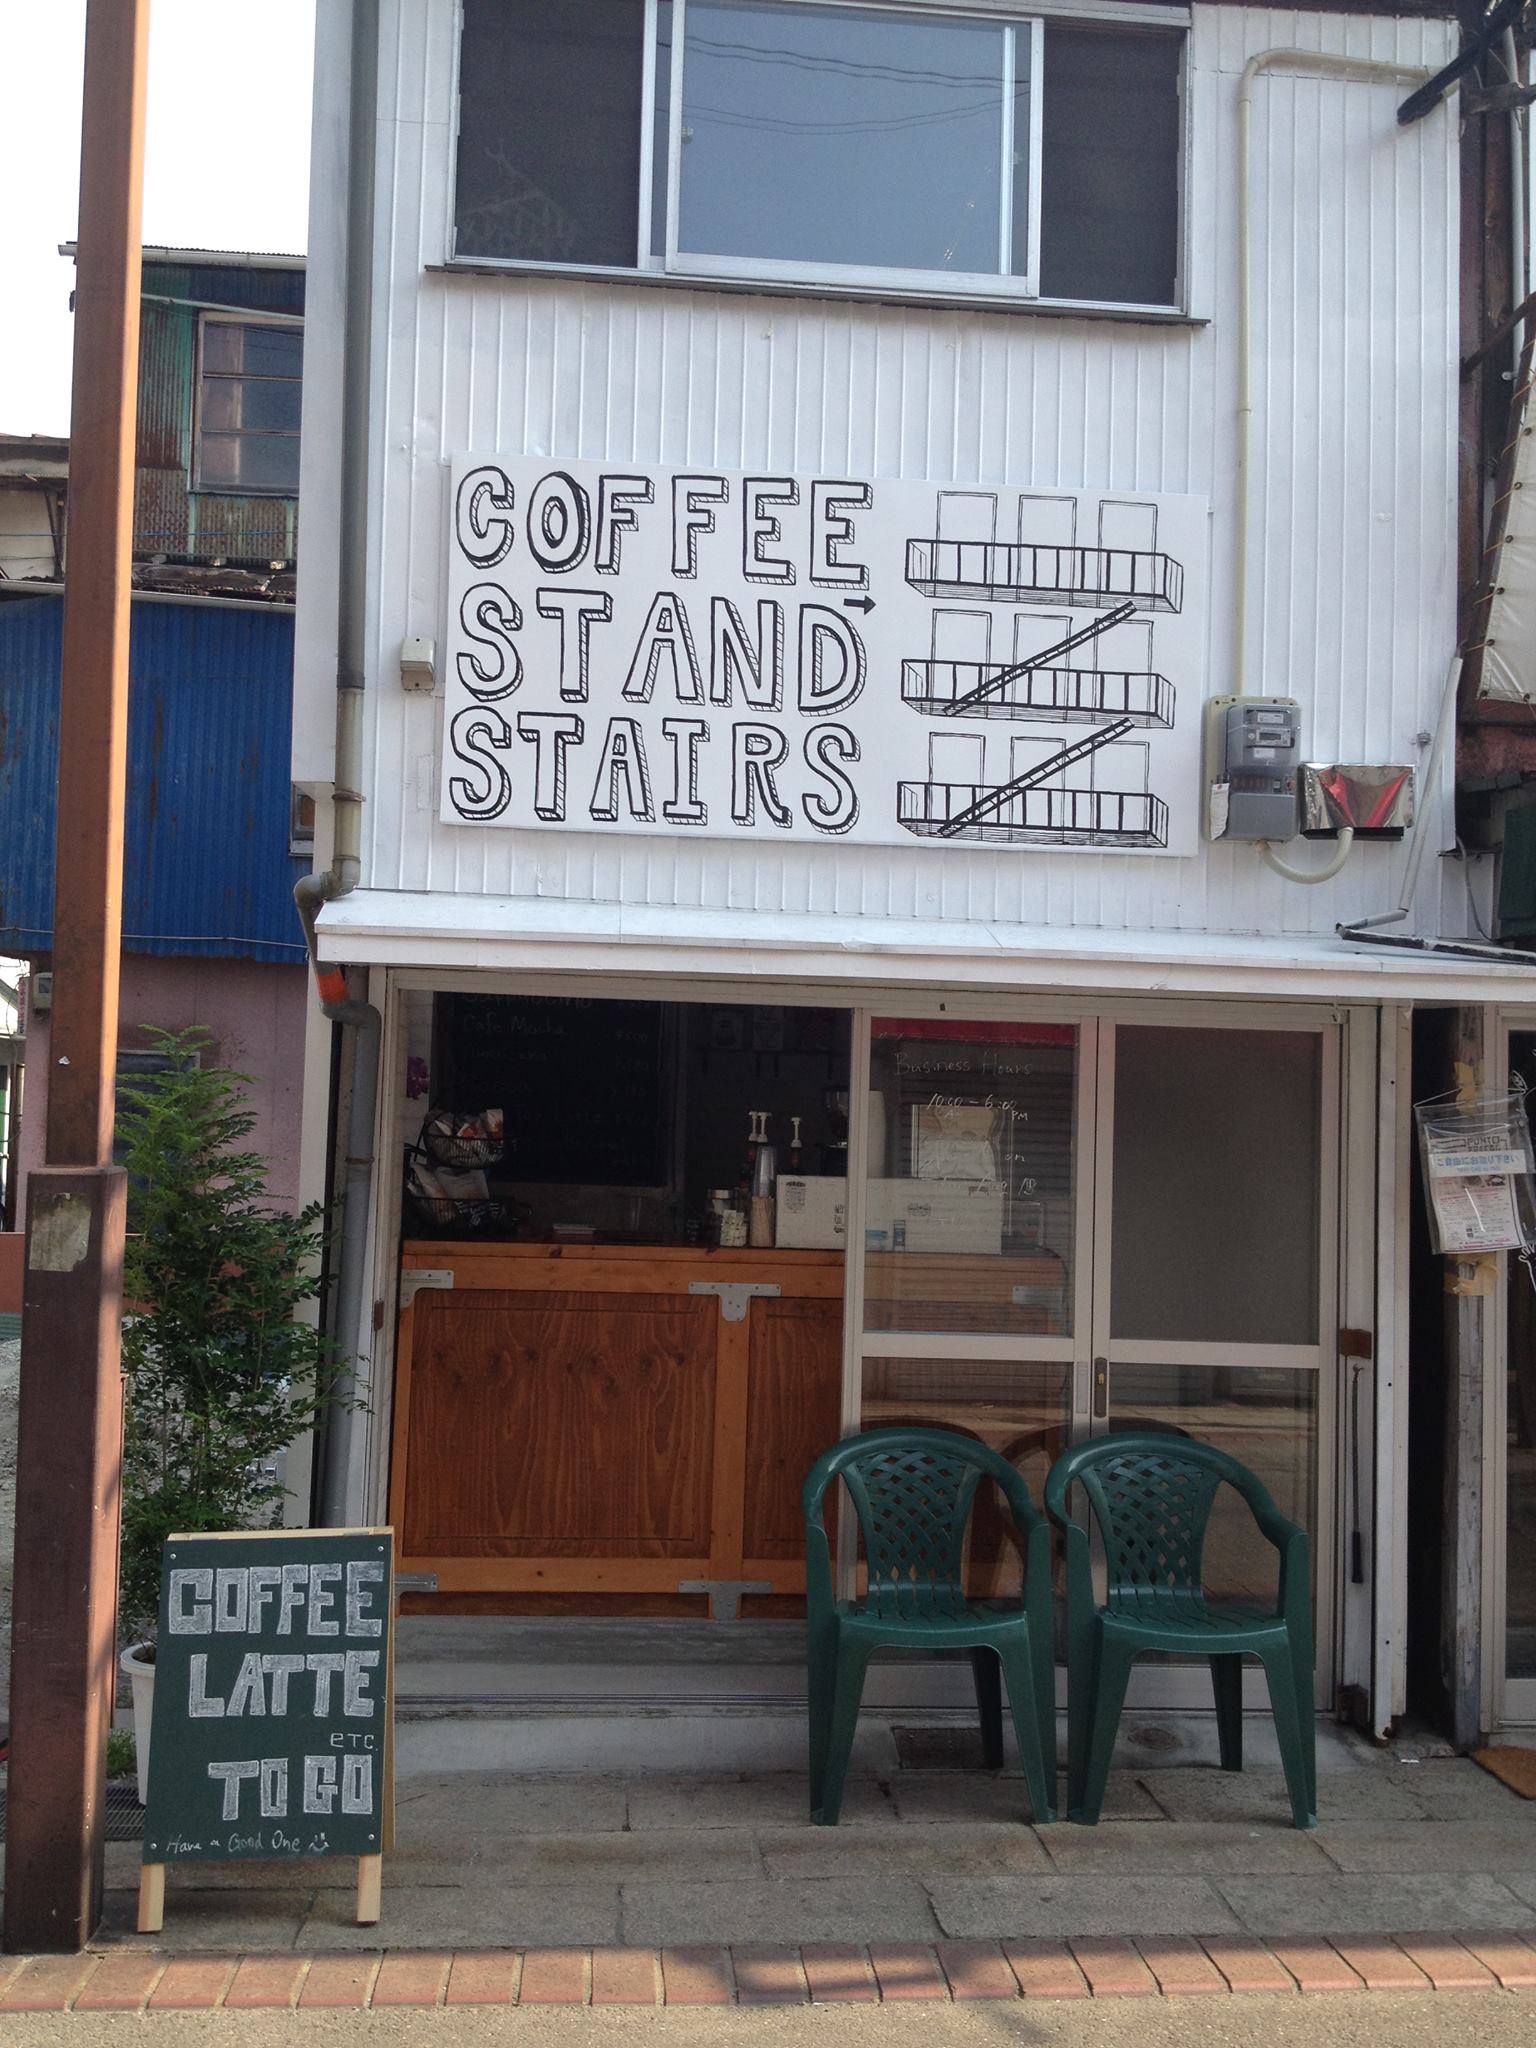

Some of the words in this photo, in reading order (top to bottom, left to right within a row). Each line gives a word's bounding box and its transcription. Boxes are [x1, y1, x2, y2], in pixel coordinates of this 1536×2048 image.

[455, 465, 873, 590] COFFEE
[456, 582, 868, 718] STAND
[449, 705, 861, 835] STAIRS
[895, 1053, 970, 1076] Business
[981, 1050, 1033, 1077] Hours
[168, 1561, 385, 1637] COFFEE
[188, 1650, 380, 1718] LATTE
[208, 1758, 289, 1820] TO
[303, 1754, 373, 1815] GO
[166, 1834, 202, 1854] Have
[228, 1832, 264, 1852] Good
[271, 1830, 300, 1851] One
